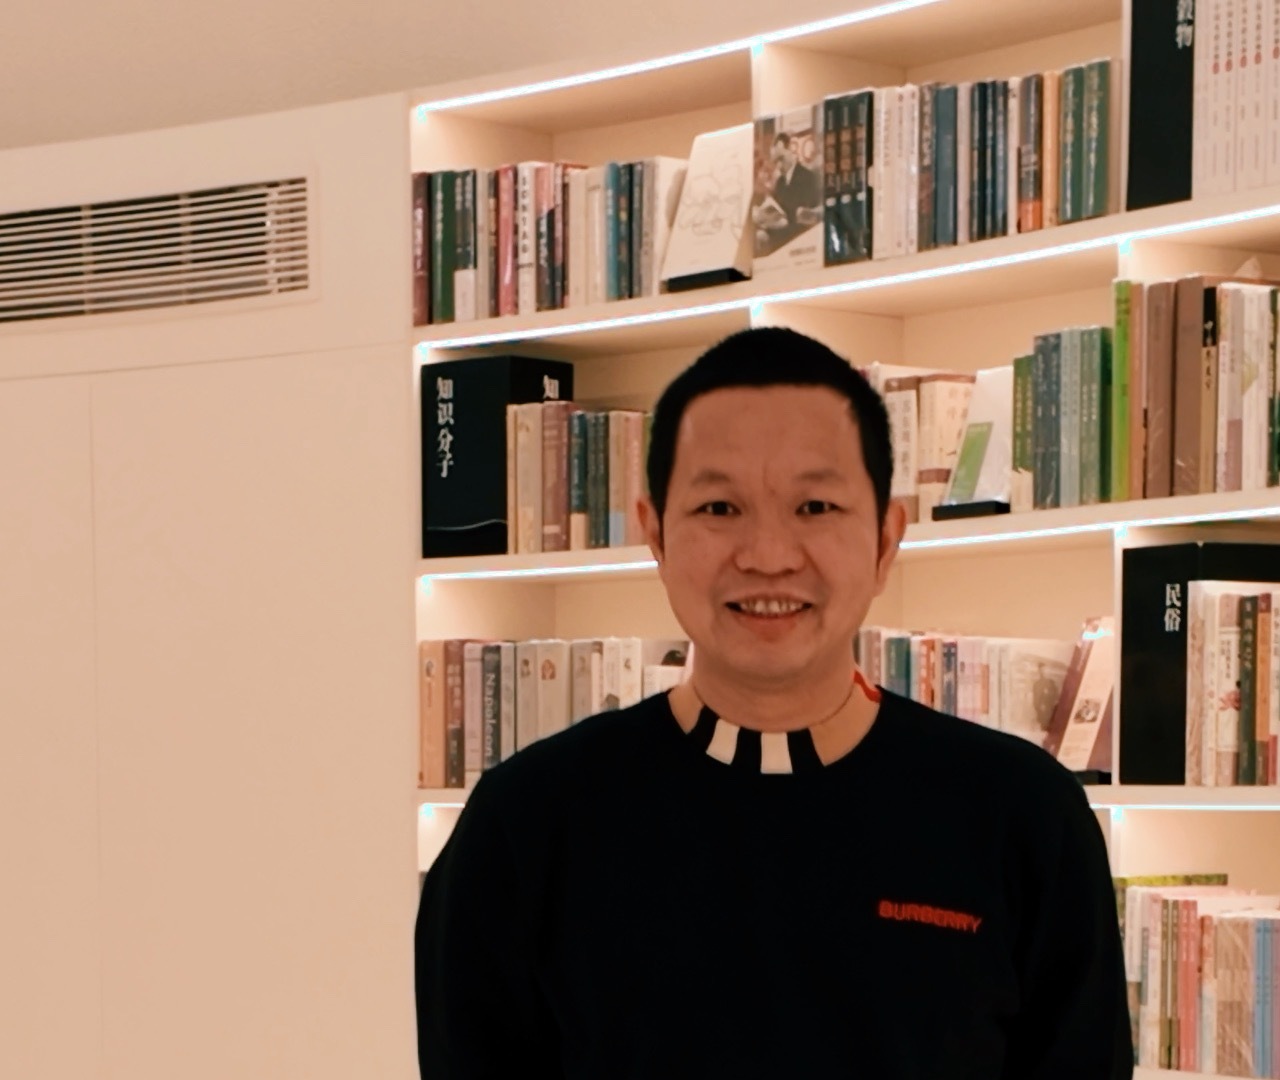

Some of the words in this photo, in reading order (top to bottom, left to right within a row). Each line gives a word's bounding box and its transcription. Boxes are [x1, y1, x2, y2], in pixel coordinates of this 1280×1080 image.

[436, 376, 454, 478] 知识分子
[1164, 583, 1181, 632] 民俗
[878, 900, 982, 934] BURBERRY
